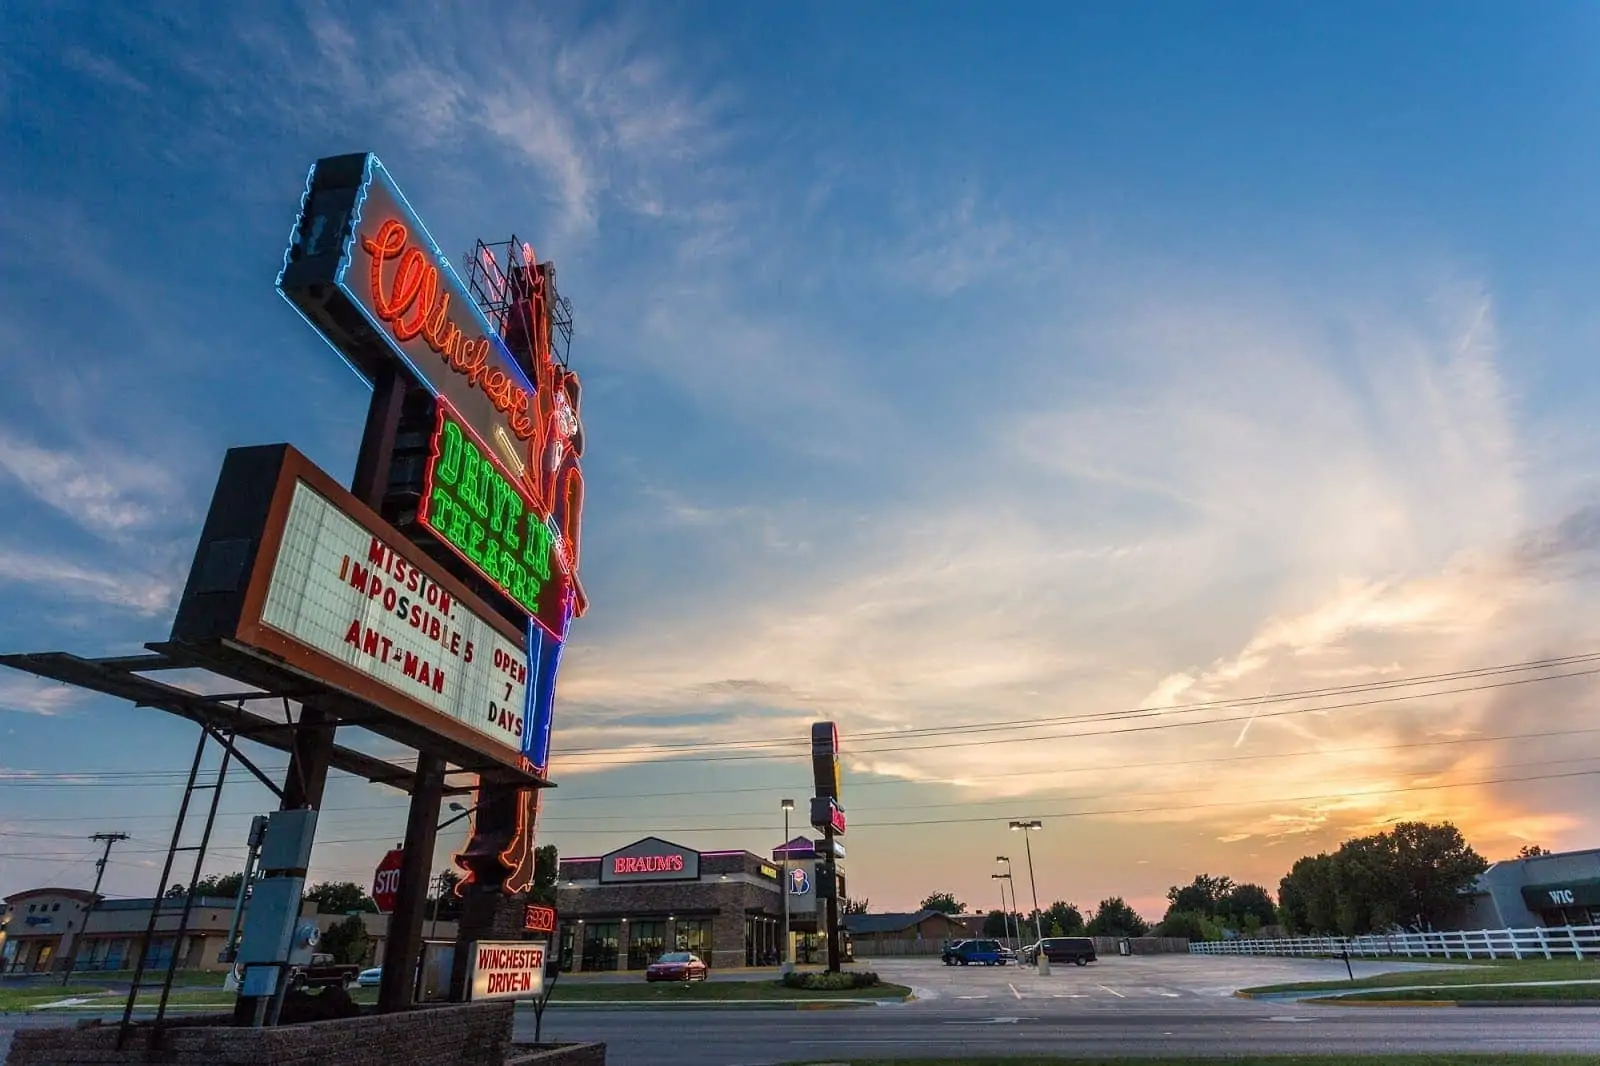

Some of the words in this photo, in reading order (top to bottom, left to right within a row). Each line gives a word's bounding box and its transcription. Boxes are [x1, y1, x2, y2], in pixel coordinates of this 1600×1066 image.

[361, 219, 538, 440] Wincheste
[437, 419, 523, 550] DRIVE
[523, 511, 555, 581] IN
[431, 486, 541, 613] THEATRE
[367, 537, 457, 620] MISSION:
[339, 554, 461, 656] IMPOSSIBLE
[463, 640, 474, 663] 5
[344, 618, 445, 694] ANT-MAN
[494, 648, 527, 686] OPEN
[503, 682, 513, 702] 7
[487, 700, 524, 737] DAYS
[375, 868, 401, 894] STO
[613, 853, 684, 874] BRAUM'S
[1548, 889, 1575, 905] WIC
[478, 948, 543, 970] WINCHESTER
[487, 972, 532, 994] DRIVE-IN
